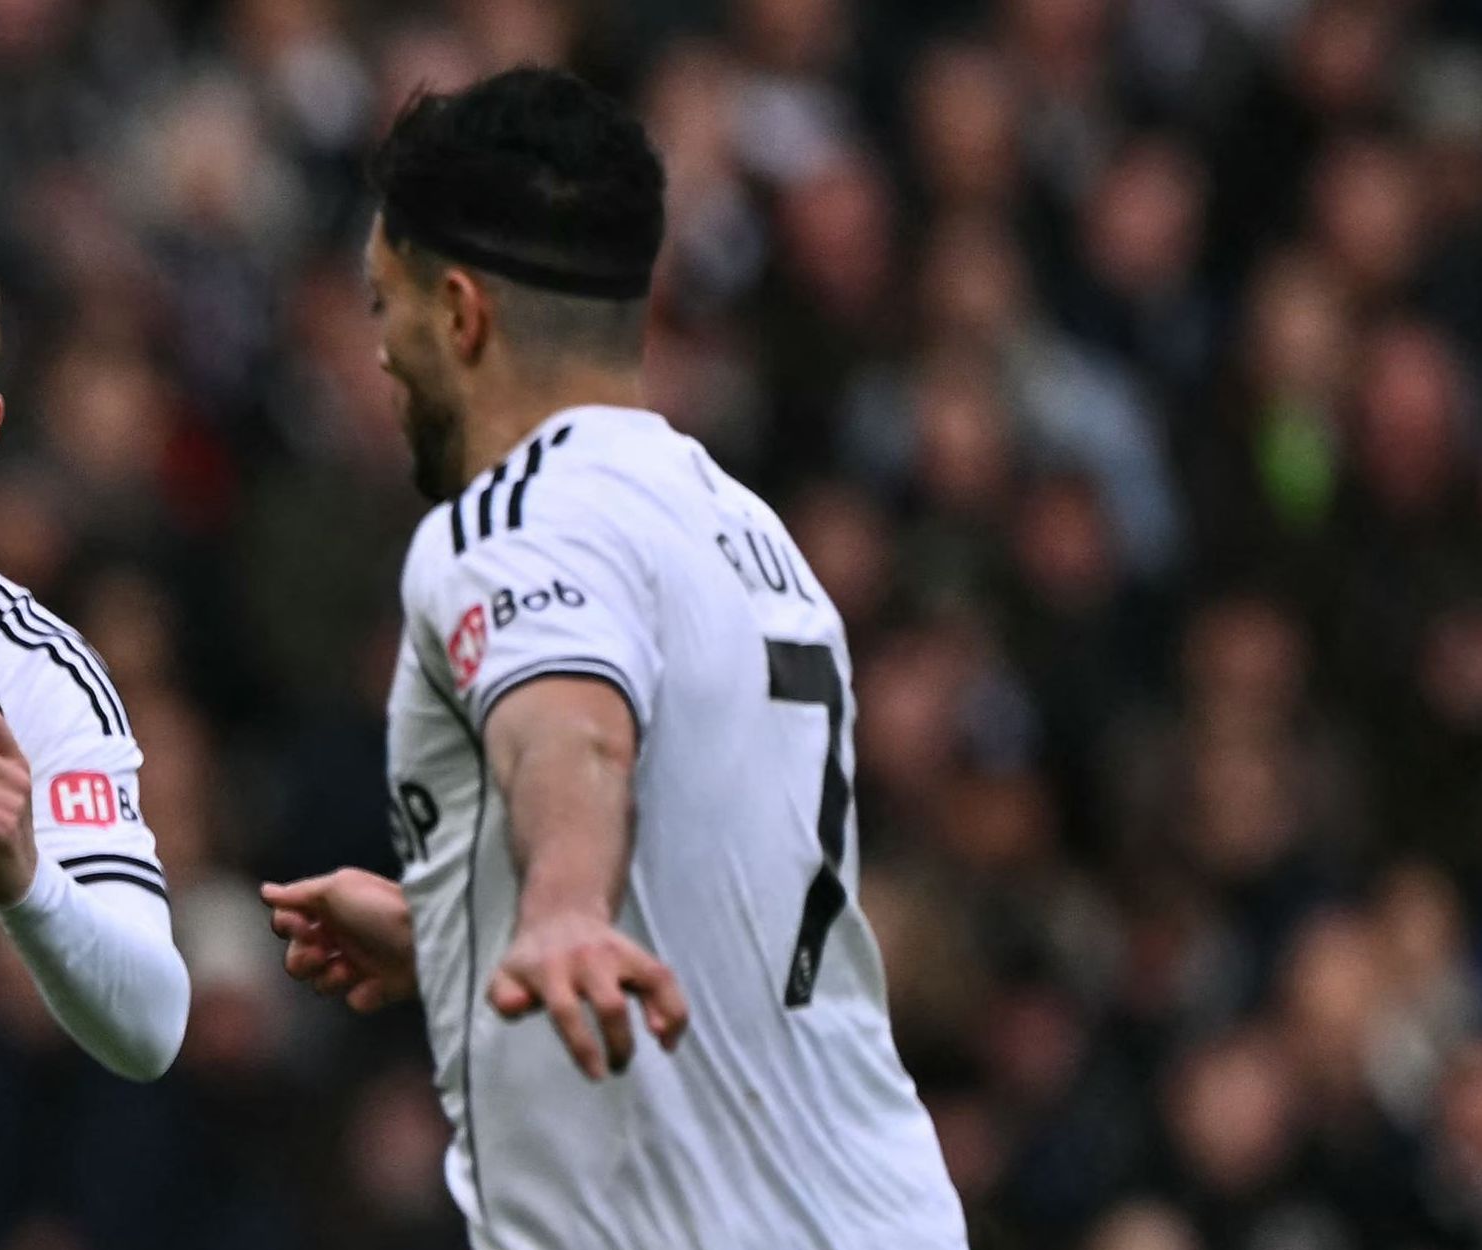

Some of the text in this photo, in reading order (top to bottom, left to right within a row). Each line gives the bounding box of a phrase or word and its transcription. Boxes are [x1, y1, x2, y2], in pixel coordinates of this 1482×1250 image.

[491, 579, 586, 631] Bob
[57, 779, 111, 822] Hi
[764, 637, 849, 1007] 7
